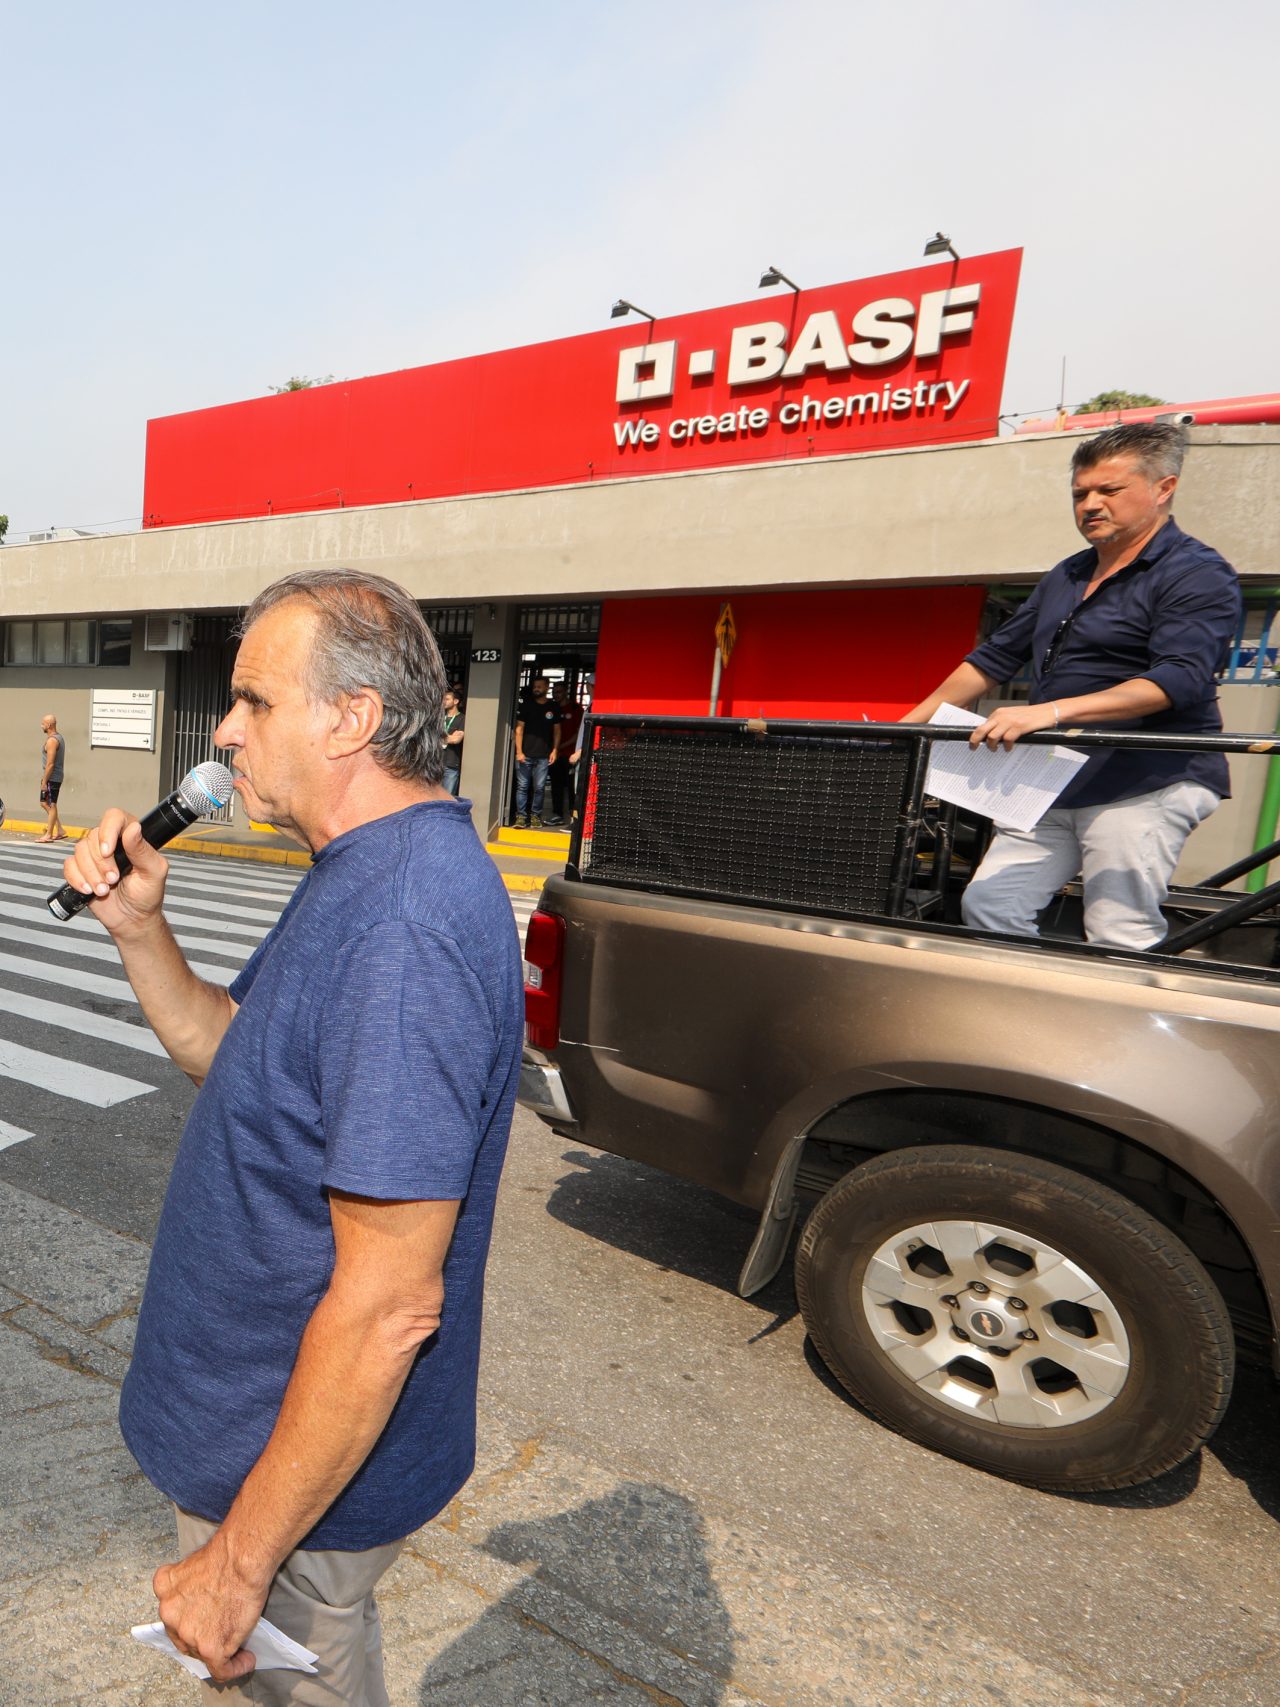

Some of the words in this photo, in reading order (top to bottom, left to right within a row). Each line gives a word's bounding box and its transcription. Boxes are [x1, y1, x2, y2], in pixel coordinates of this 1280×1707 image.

[727, 283, 982, 386] BASF
[613, 418, 660, 447] We
[668, 404, 770, 440] create
[778, 378, 971, 426] chemistry
[475, 650, 497, 662] 123
